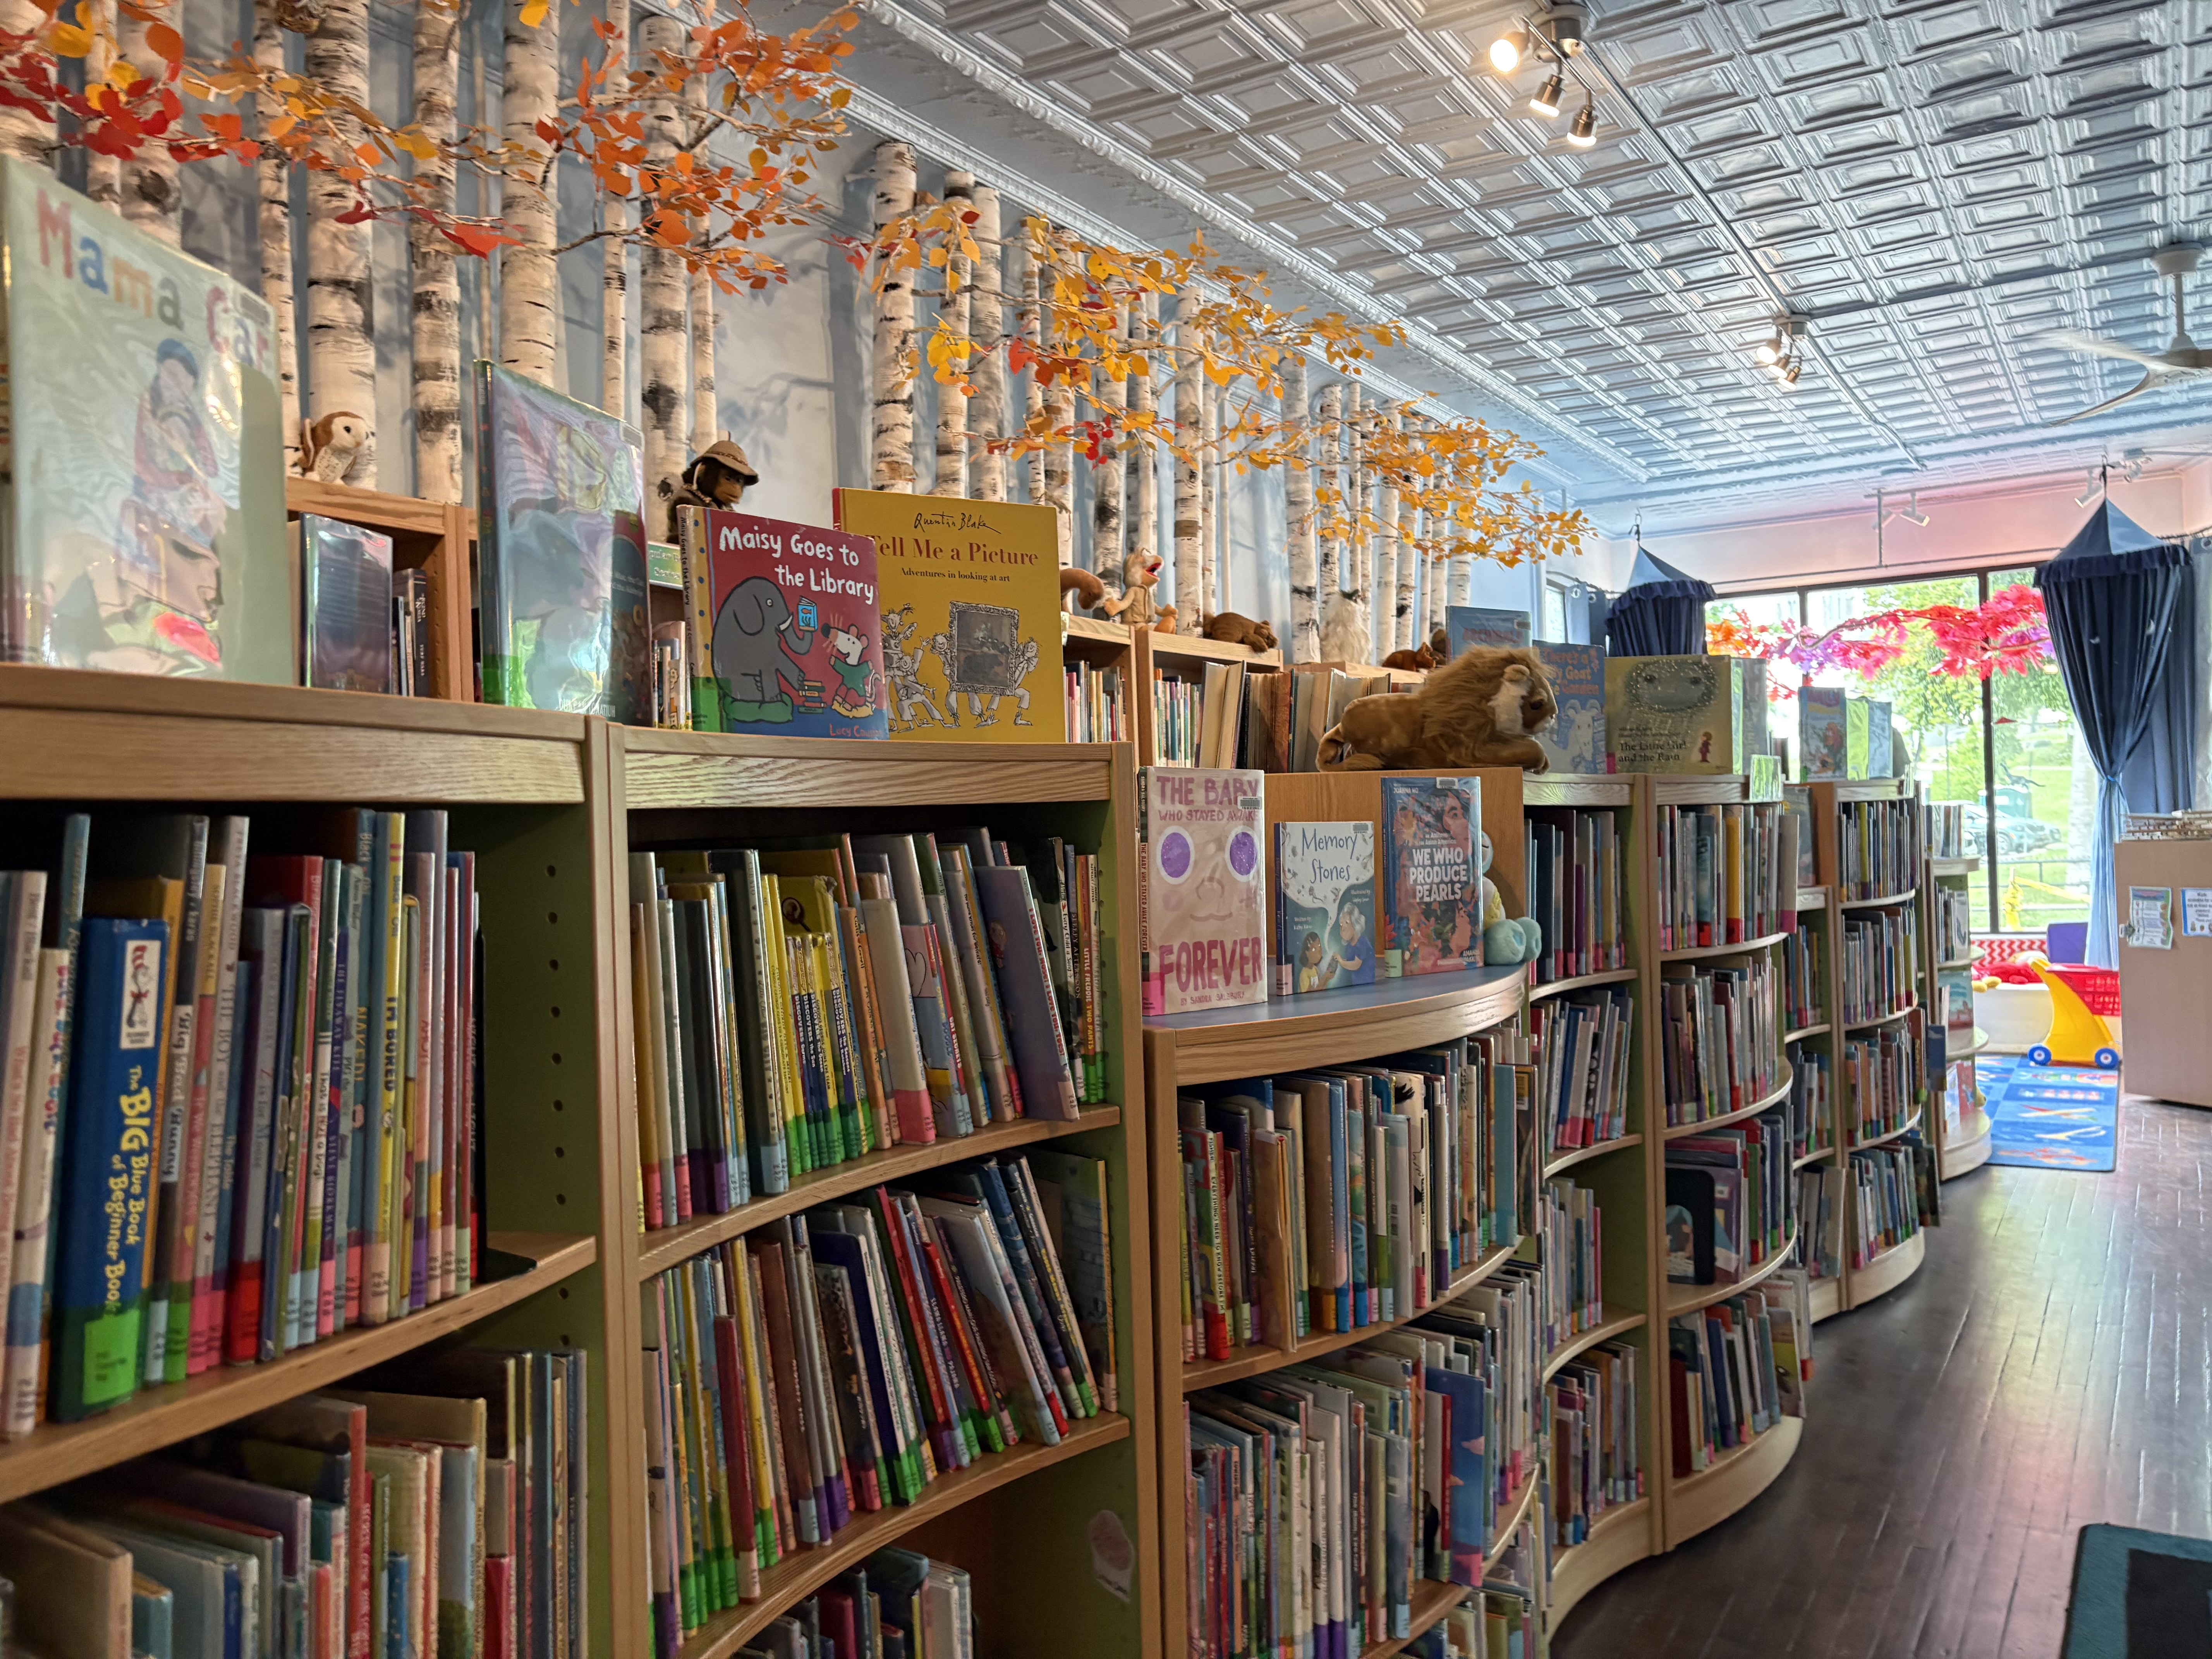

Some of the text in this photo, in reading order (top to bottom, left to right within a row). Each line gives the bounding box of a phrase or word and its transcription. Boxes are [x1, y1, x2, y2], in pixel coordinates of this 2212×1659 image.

[36, 188, 108, 331] Mama
[914, 511, 1001, 534] Quentin Blake
[719, 526, 859, 566] Maisy Goes to
[912, 538, 1039, 566] Me a Picture
[775, 565, 874, 605] the Library
[900, 567, 946, 579] Adventures
[958, 572, 988, 582] looking
[1566, 666, 1591, 680] Goat
[830, 723, 850, 737] Lucy
[1156, 776, 1260, 805] THE BABY
[1158, 809, 1224, 822] WHO STAYED
[359, 832, 372, 862] Black
[1302, 827, 1358, 859] Memory
[1412, 847, 1463, 866] WE WHO
[1310, 858, 1350, 884] Stones
[1410, 864, 1467, 884] PRODUCE
[1416, 883, 1462, 902] PEARLS
[1159, 936, 1263, 997] FOREVER
[795, 995, 804, 1042] DISCOVERS
[803, 994, 813, 1041] DISCOVERS
[811, 993, 819, 1040] DISCOVERS
[833, 990, 842, 1036] DISCOVERS
[836, 988, 846, 1034] DISCOVERS
[1190, 994, 1212, 1005] SANDRA
[176, 1012, 193, 1050] Big
[847, 1002, 855, 1043] Adventures
[353, 1006, 368, 1082] NAKED!
[384, 1029, 397, 1092] BORED
[952, 1033, 962, 1068] SECRETS
[128, 1065, 143, 1091] The
[120, 1087, 151, 1152] BIG
[204, 983, 235, 1219] THE BOY ELEPHANT
[166, 1106, 184, 1176] Bunny
[130, 1152, 149, 1195] Blue
[105, 1154, 129, 1259] of Beginner
[124, 1197, 146, 1246] Book
[931, 1298, 959, 1389] LLAMA LLAMA PAJAMA
